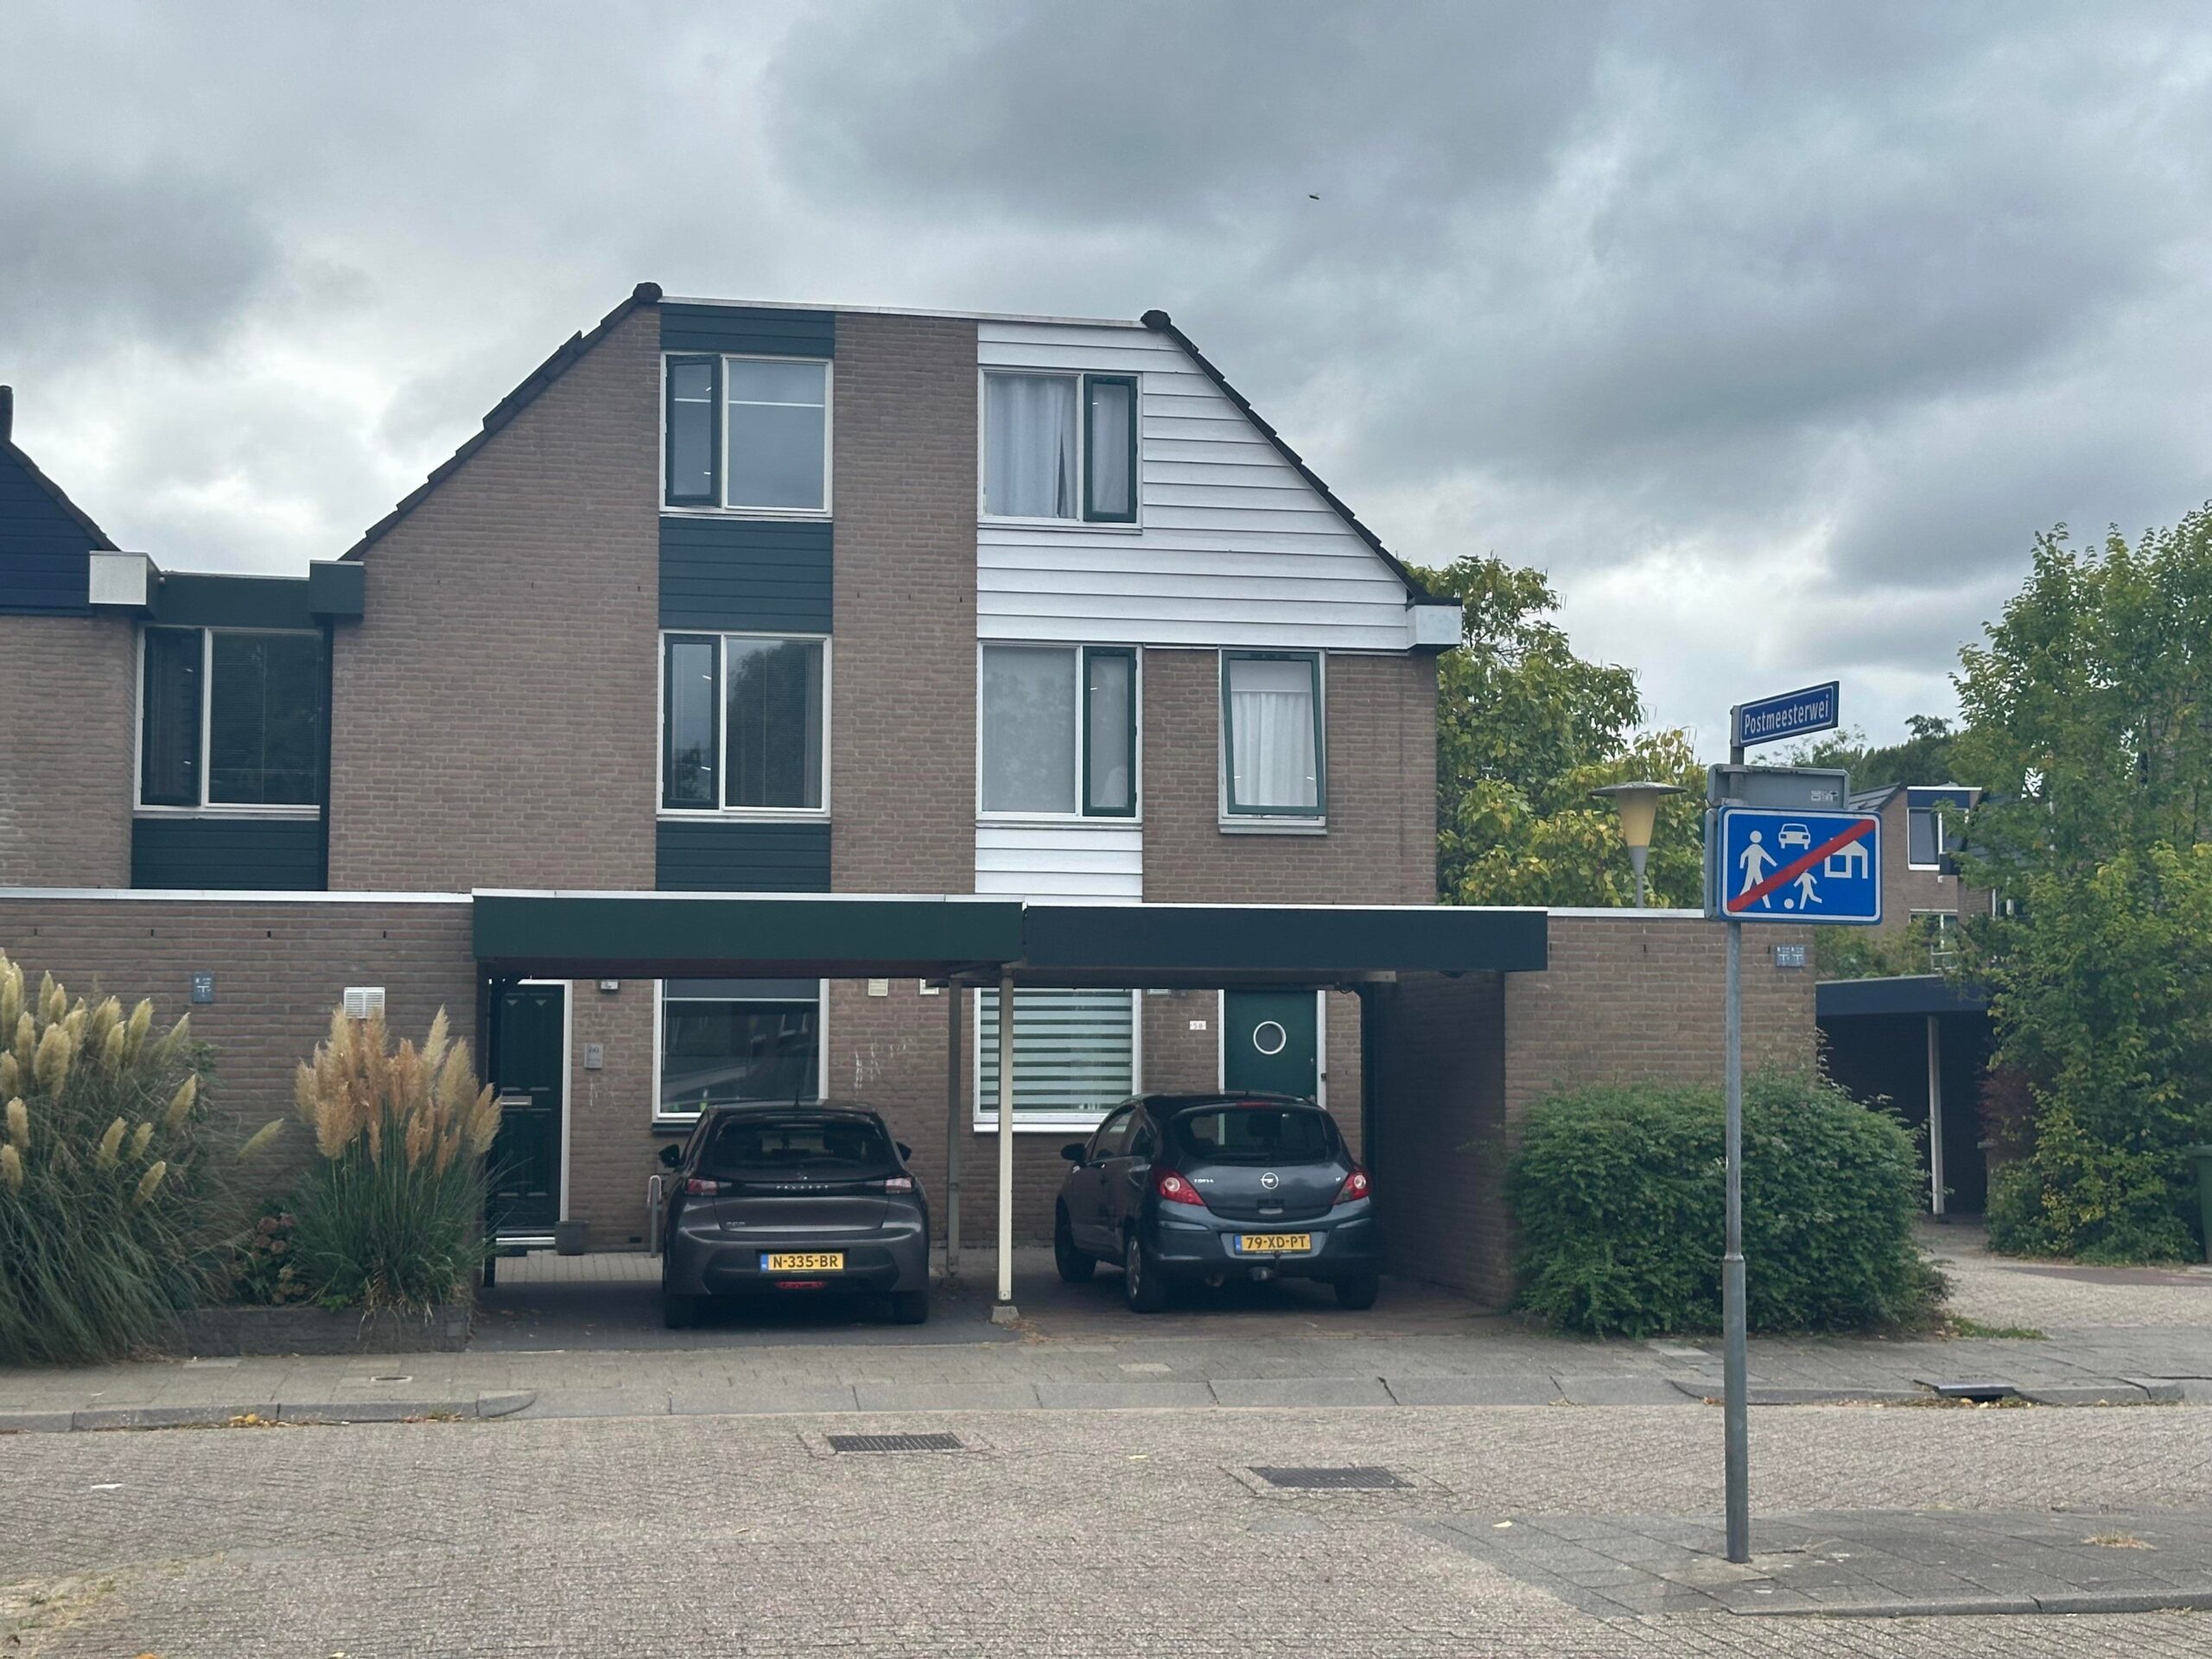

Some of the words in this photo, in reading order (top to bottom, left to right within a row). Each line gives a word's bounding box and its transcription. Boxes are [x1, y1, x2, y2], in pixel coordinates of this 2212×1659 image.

[1745, 693, 1829, 735] Postmeesterwei
[1246, 1236, 1306, 1249] 79-XD-PT
[773, 1255, 838, 1268] N-335-BR
